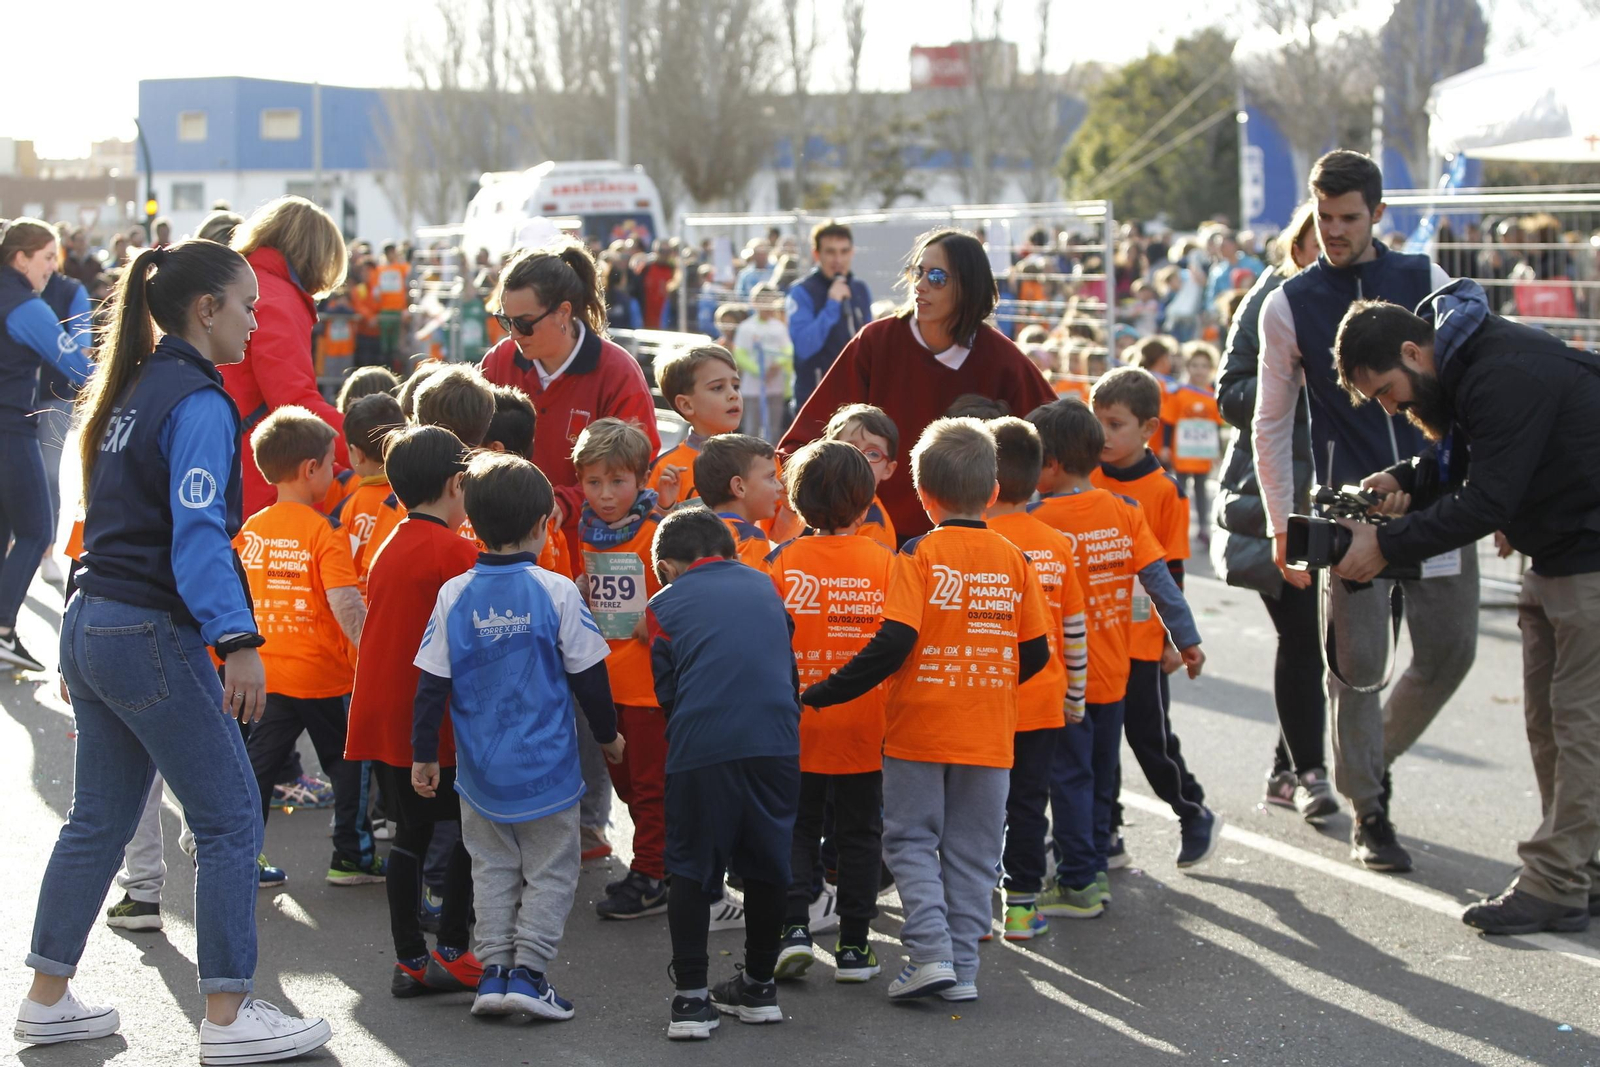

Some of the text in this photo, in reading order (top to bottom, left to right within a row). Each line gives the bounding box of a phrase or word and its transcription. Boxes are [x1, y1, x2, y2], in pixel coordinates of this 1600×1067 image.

[1084, 527, 1119, 541] MEDIO
[270, 538, 299, 549] MEDIO
[1087, 547, 1133, 565] ALMERÍA
[268, 560, 309, 572] ALMERÍA
[610, 564, 637, 572] INFANTIL
[267, 570, 301, 579] 03/02/2019
[969, 573, 1010, 584] MEDIO
[590, 574, 636, 601] 259
[828, 577, 871, 589] MEDIO
[969, 586, 1023, 603] MARATN
[600, 601, 622, 609] PEREZ
[827, 601, 884, 615] ALMERÍA
[827, 615, 874, 624] 03/02/2019
[967, 611, 1013, 621] 03/02/2019
[480, 625, 504, 636] CORRE
[504, 625, 511, 633] X
